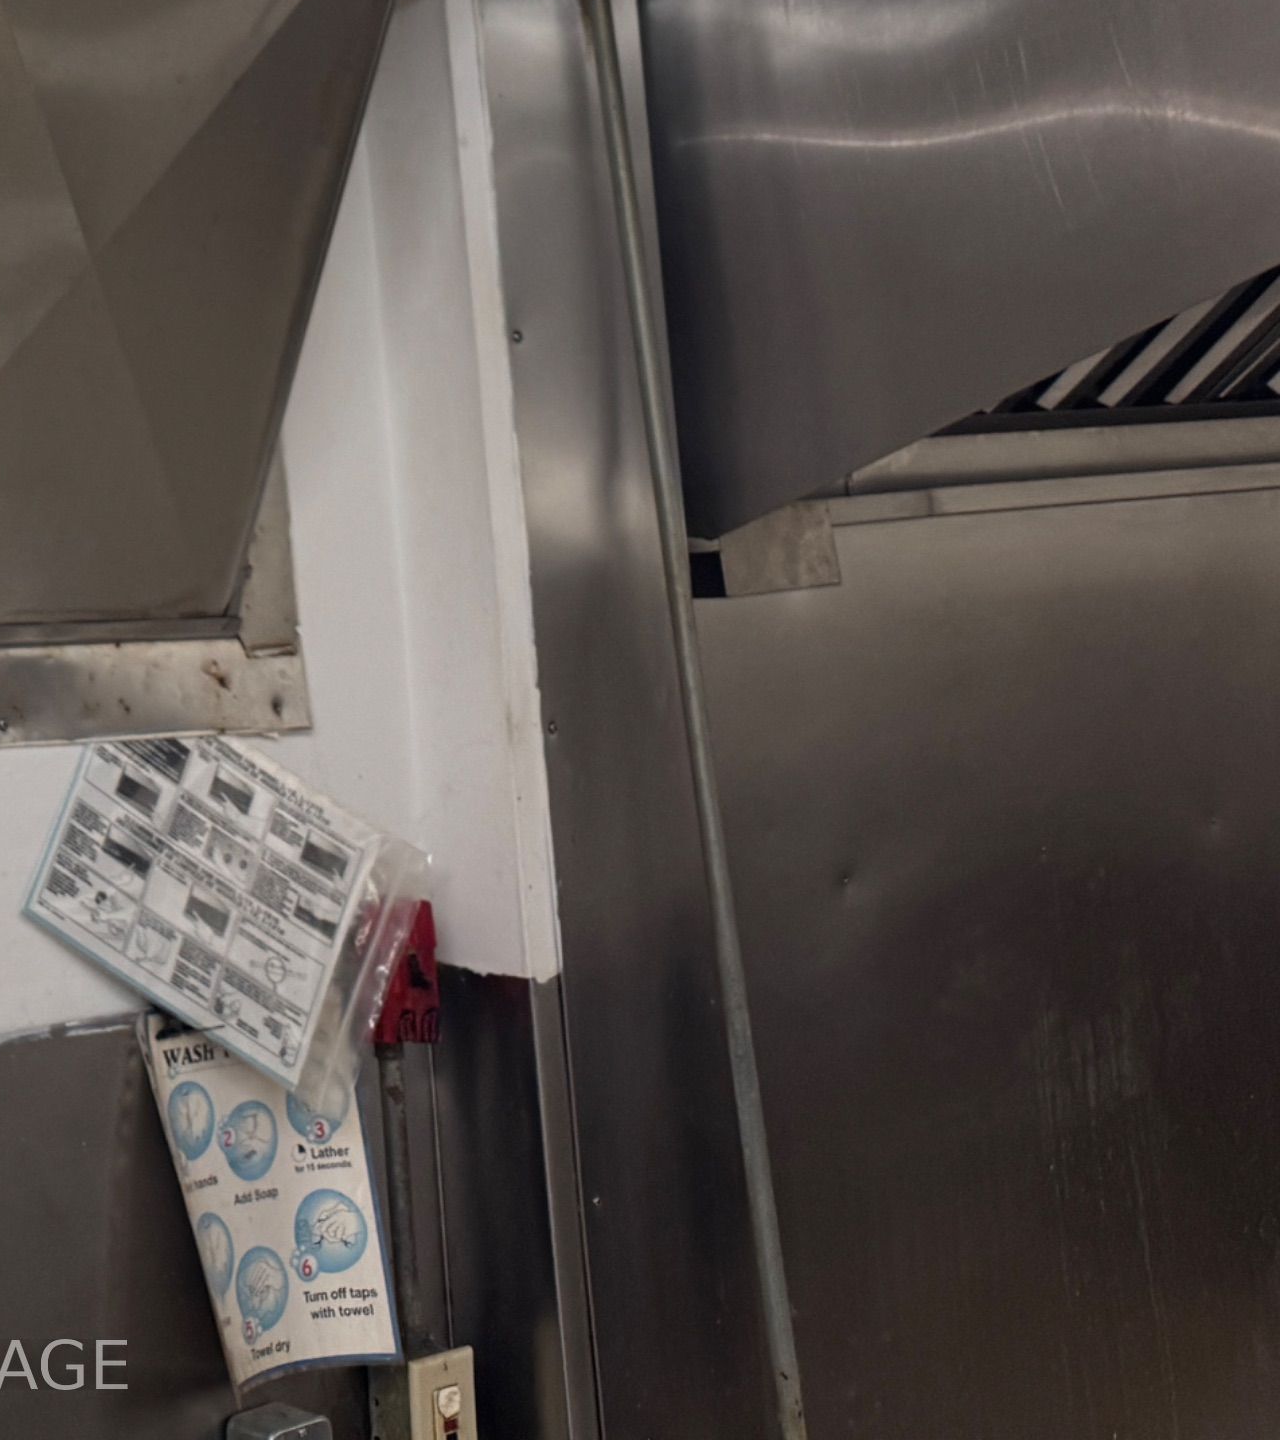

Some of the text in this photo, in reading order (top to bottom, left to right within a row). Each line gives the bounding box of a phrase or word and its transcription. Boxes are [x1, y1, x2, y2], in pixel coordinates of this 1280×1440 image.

[163, 1045, 214, 1067] WASH
[315, 1121, 325, 1138] 3
[223, 1131, 232, 1147] 2
[311, 1146, 349, 1159] Lather
[295, 1161, 352, 1173] for 15 seconds
[234, 1188, 278, 1205] Add Soap
[302, 1259, 312, 1277] 6
[303, 1287, 378, 1304] Turn off taps
[310, 1304, 374, 1320] with towel
[246, 1321, 254, 1338] 5
[251, 1339, 291, 1360] Towel dry
